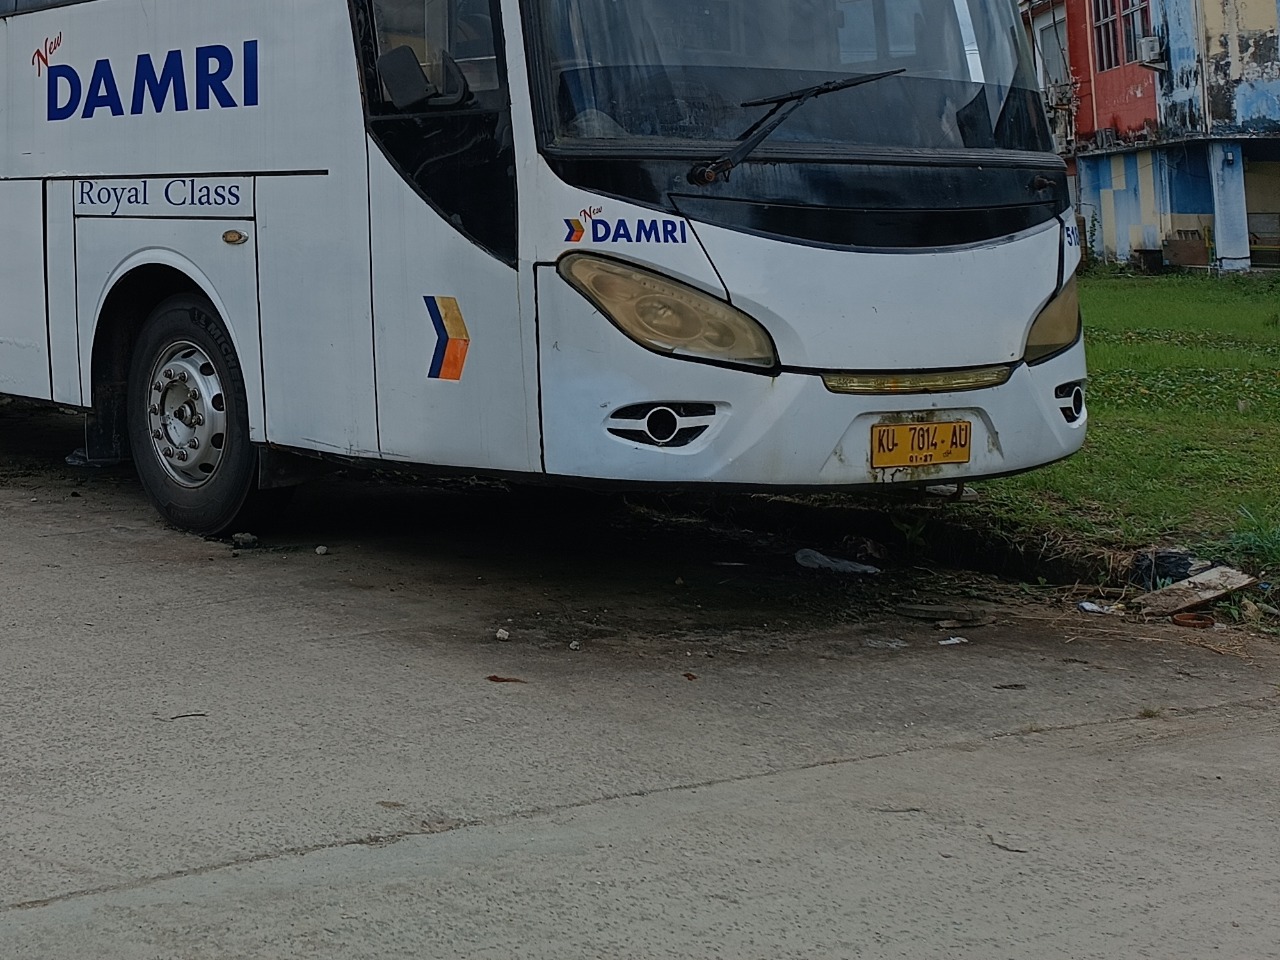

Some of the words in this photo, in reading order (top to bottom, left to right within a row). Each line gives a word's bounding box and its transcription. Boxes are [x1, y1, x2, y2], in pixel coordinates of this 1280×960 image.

[32, 31, 62, 77] New
[47, 39, 259, 122] DAMRI
[78, 180, 149, 216] Royal
[164, 178, 240, 206] Class
[580, 205, 603, 223] New
[592, 219, 687, 243] DAMRI
[950, 424, 968, 448] AU
